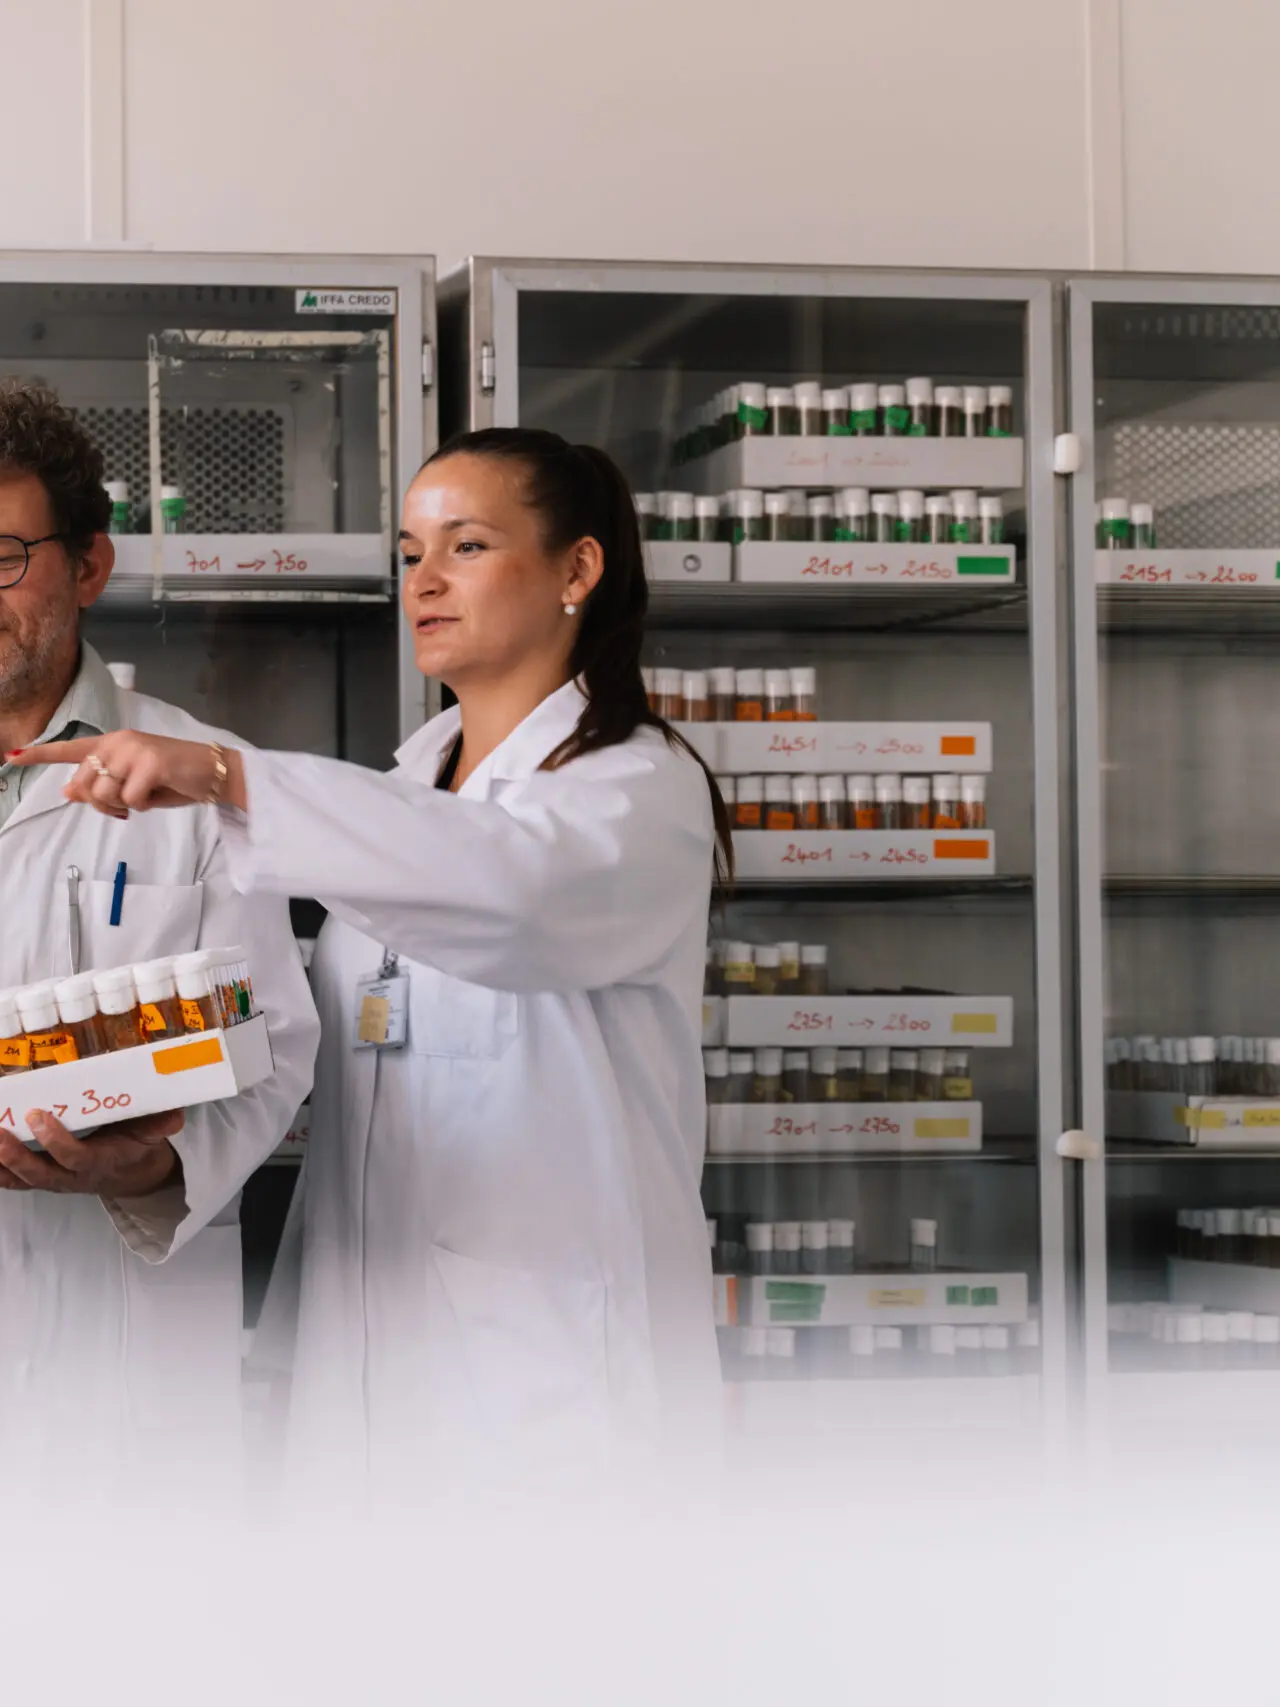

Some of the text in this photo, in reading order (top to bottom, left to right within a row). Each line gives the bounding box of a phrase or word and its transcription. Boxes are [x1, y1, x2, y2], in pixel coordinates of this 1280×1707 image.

[320, 294, 391, 306] IFFA CREDO
[185, 549, 309, 573] 701 750
[800, 556, 953, 579] 2101 2150
[1119, 563, 1259, 583] 2151 2200
[767, 732, 818, 757] 2451
[780, 843, 929, 865] 2401 2450
[881, 1012, 932, 1031] 2800
[81, 1088, 132, 1115] 300
[766, 1116, 901, 1136] 2701 2750
